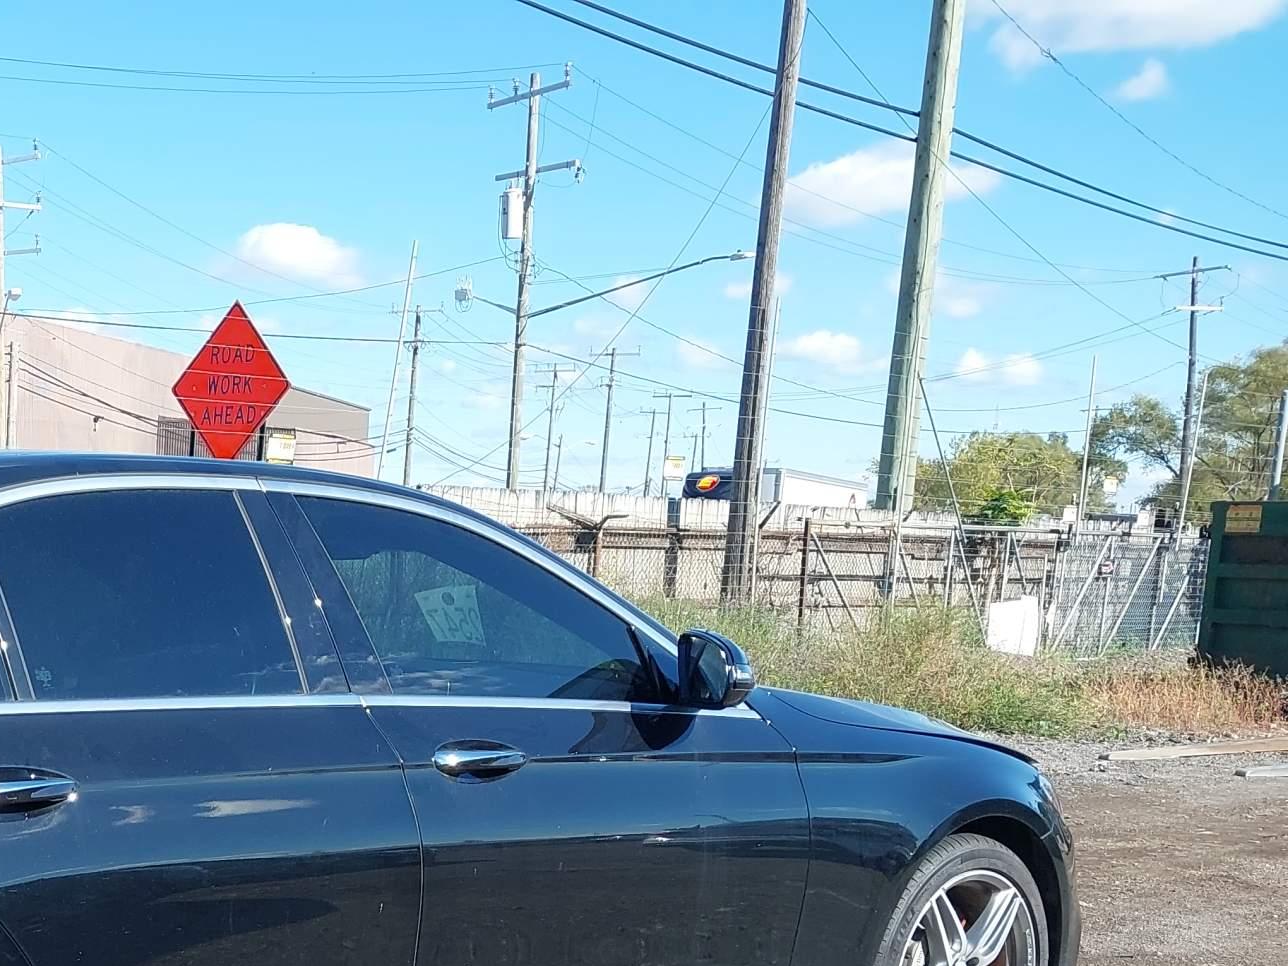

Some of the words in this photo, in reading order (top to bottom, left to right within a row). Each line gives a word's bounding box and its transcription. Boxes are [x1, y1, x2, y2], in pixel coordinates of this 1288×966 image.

[210, 344, 256, 365] ROAD
[208, 374, 252, 396] WORK
[201, 404, 257, 426] AHEAD
